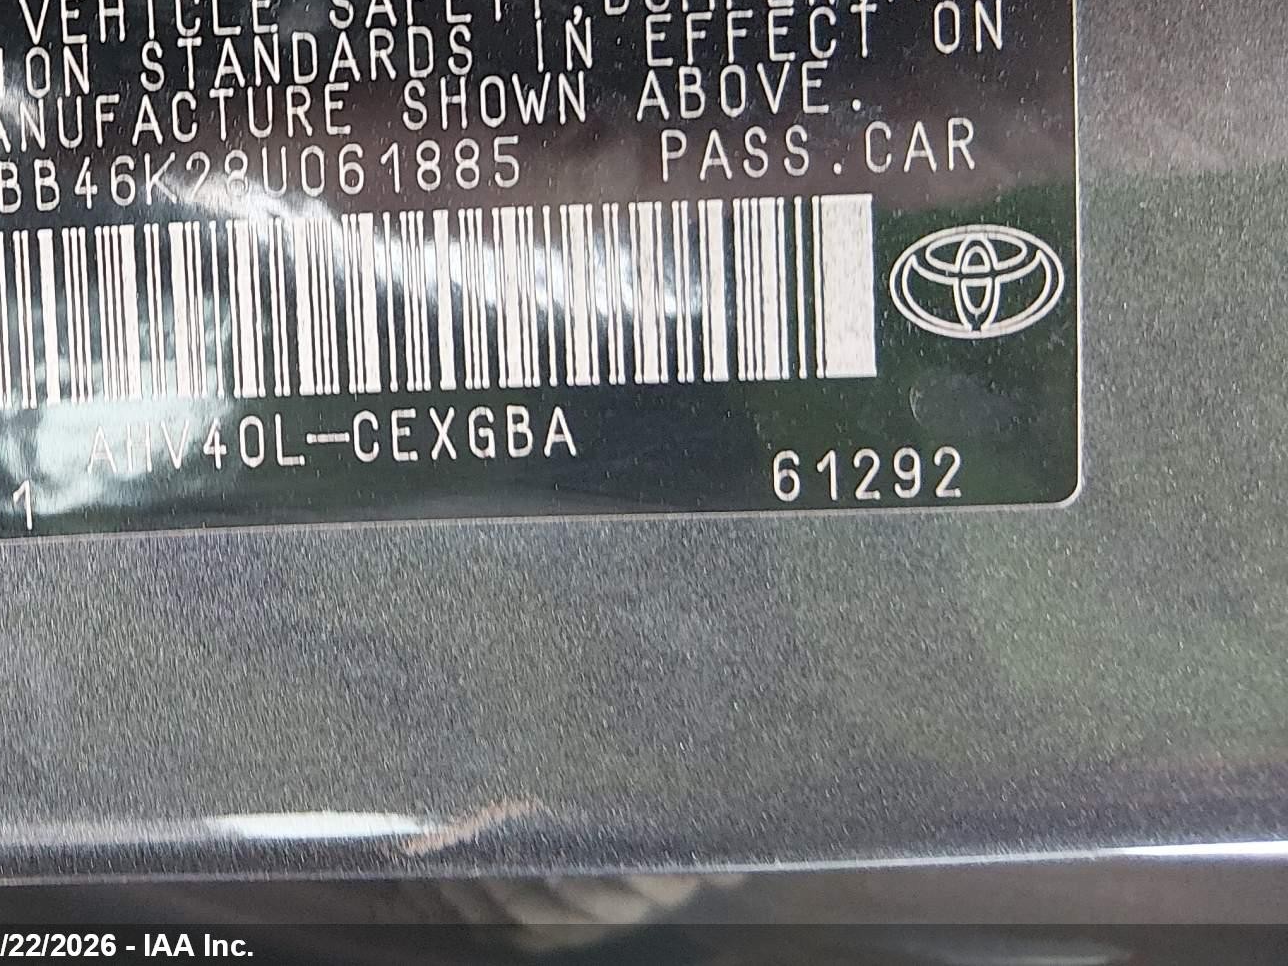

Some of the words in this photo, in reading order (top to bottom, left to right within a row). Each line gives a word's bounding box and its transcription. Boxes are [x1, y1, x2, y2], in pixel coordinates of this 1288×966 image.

[140, 25, 473, 93] STANDARDS
[533, 15, 594, 73] IN
[402, 70, 587, 132] SHOWN
[636, 60, 863, 122] ABOVE.
[660, 116, 977, 183] PASS.CAR
[771, 445, 963, 505] 61292
